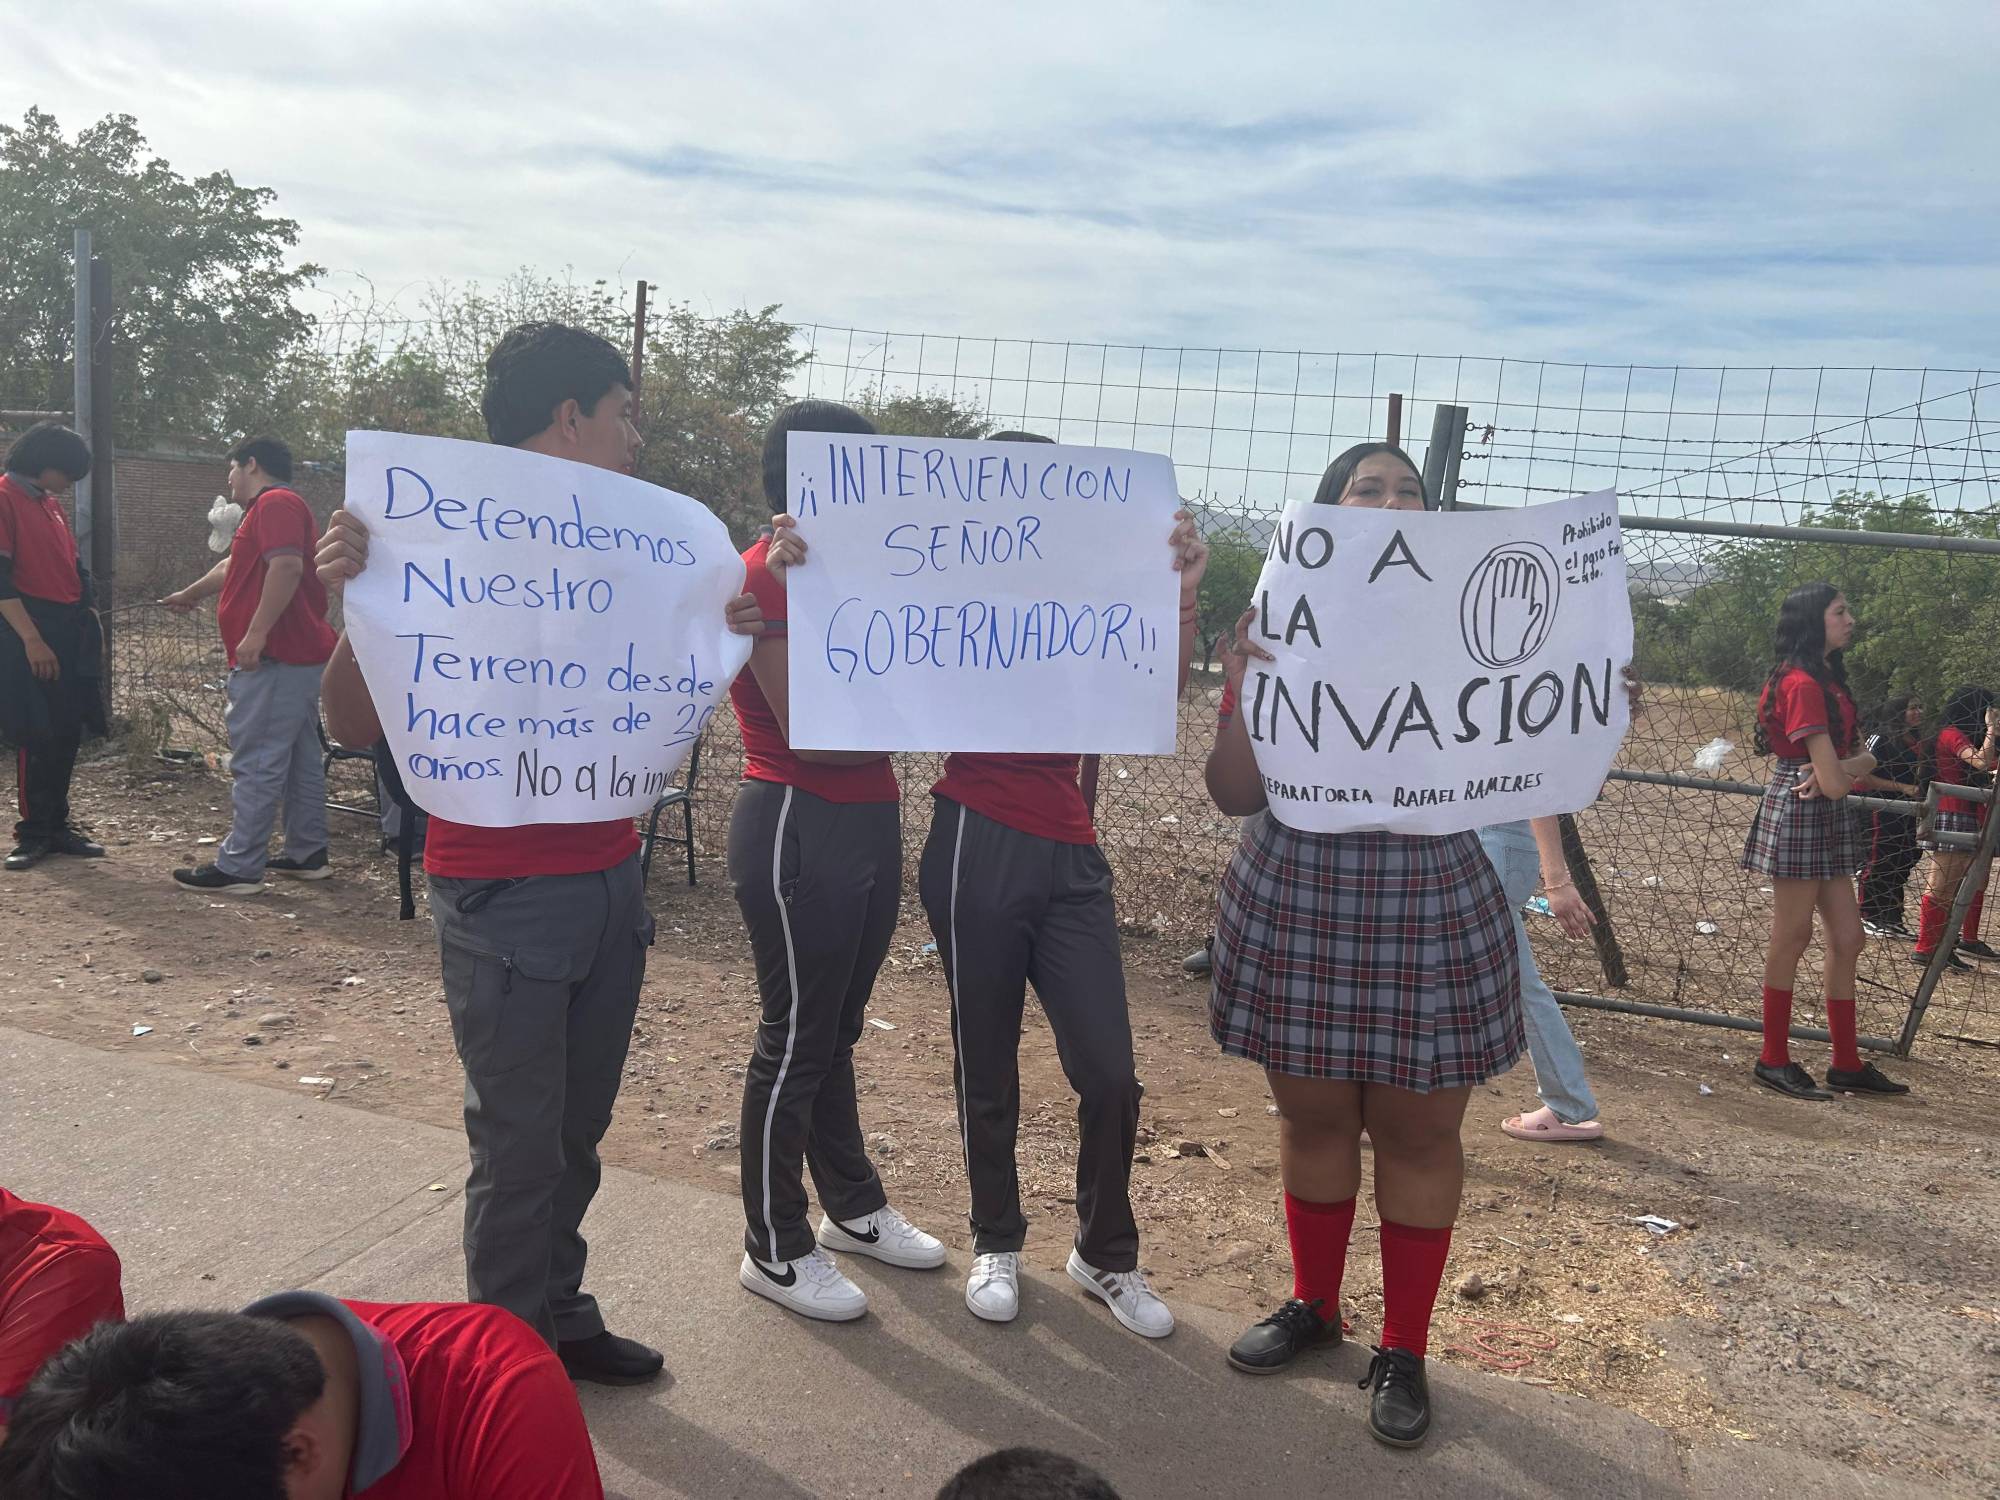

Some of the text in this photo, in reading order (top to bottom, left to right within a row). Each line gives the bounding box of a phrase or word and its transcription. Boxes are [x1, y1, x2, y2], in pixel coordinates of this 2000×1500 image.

[384, 466, 696, 567] Defendemos
[1563, 512, 1612, 545] Prohibido
[885, 516, 1042, 576] SEÑOR
[1269, 520, 1433, 584] NO A
[1565, 551, 1578, 570] el
[404, 558, 612, 613] Nuestro
[826, 597, 1157, 682] GOBERNADOR!!
[1261, 590, 1321, 648] LA
[395, 633, 713, 697] Terreno desde
[408, 693, 505, 740] hace
[519, 708, 594, 739] más
[613, 702, 650, 734] de
[1252, 658, 1612, 753] INVASION
[516, 748, 561, 797] No
[576, 762, 597, 800] a
[610, 755, 636, 797] la
[1393, 787, 1456, 807] RAFAEL
[1464, 773, 1543, 800] RAMIRES
